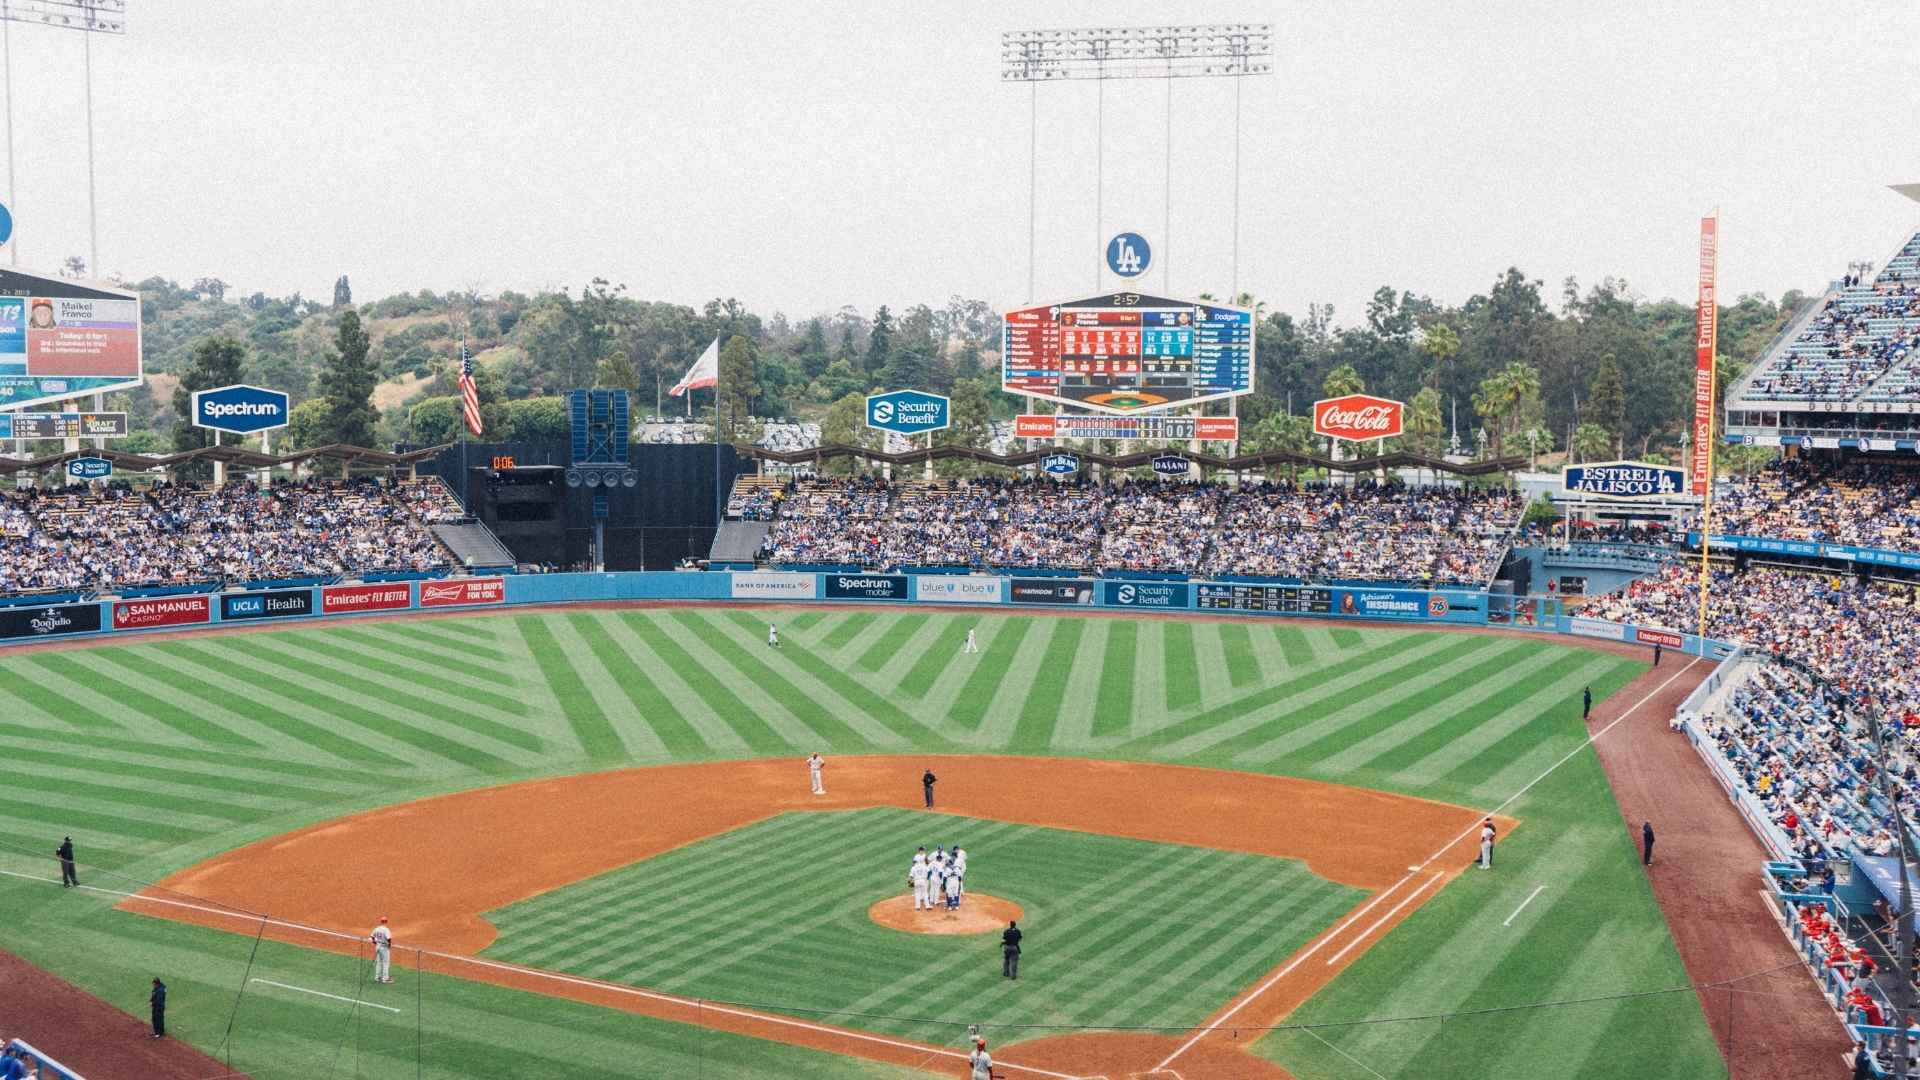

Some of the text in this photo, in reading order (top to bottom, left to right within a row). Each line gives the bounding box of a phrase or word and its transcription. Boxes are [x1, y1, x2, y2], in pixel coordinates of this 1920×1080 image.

[1116, 238, 1141, 272] LA
[1113, 295, 1140, 305] 2:57
[61, 302, 93, 311] Maikel
[1698, 287, 1713, 348] Emirates
[204, 400, 277, 419] Spectrum
[898, 401, 941, 415] Security
[898, 412, 936, 424] Benefit
[1019, 422, 1052, 431] Emirates
[1166, 425, 1194, 437] 0 0 2
[1693, 369, 1711, 483] Emirates FLY BETTER
[84, 462, 107, 471] Security
[1045, 459, 1057, 469] JIM
[1155, 462, 1187, 470] DASANI
[1573, 480, 1653, 494] JALISCO
[467, 582, 503, 591] THIS BUD'S
[839, 578, 891, 590] Spectrum
[922, 583, 944, 593] blue
[962, 583, 985, 593] blue
[467, 591, 480, 599] FOR
[866, 589, 891, 597] mobile
[1138, 585, 1174, 596] Security
[325, 590, 407, 606] Emirates FLY BETTER
[1138, 596, 1169, 605] Benefit
[130, 601, 206, 615] SAN MANUEL
[233, 595, 305, 612] UCLA Health
[1366, 601, 1419, 611] INSURANCE
[1432, 601, 1444, 610] 76
[131, 614, 162, 623] CASINO
[1639, 630, 1662, 643] Emirates
